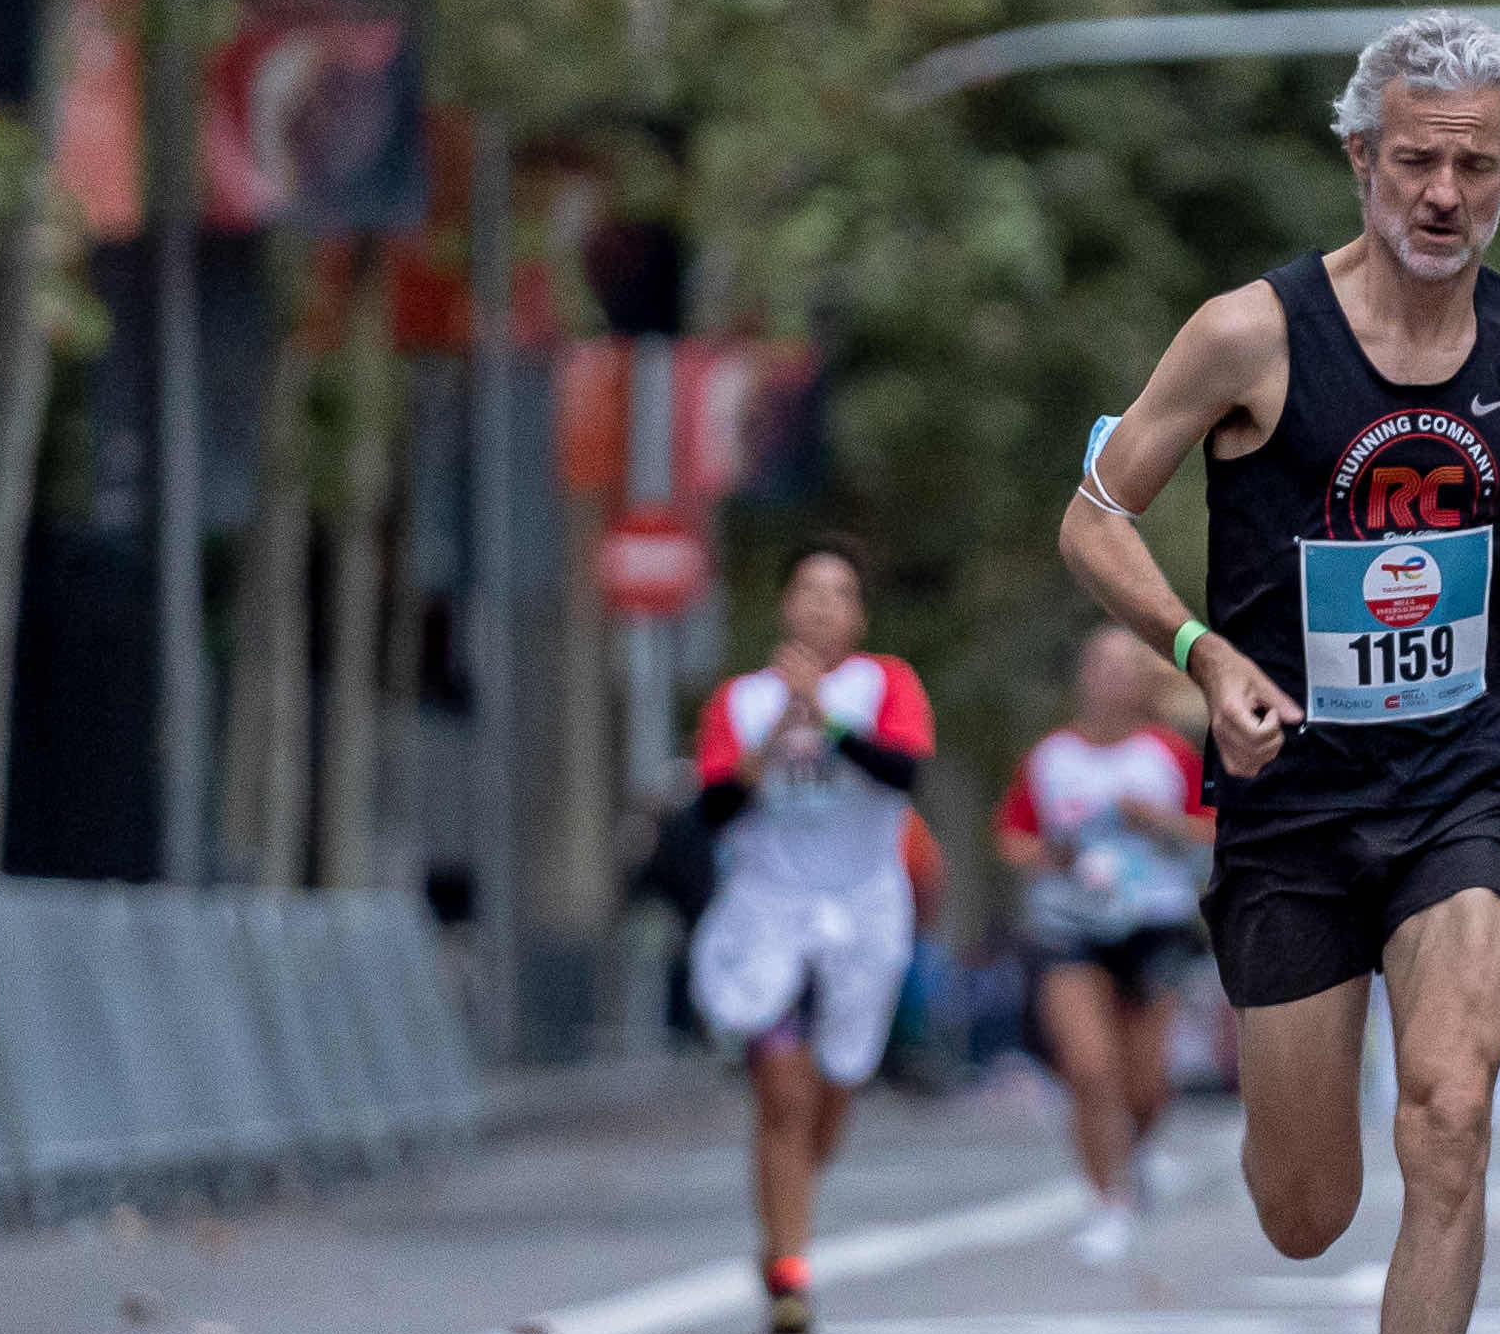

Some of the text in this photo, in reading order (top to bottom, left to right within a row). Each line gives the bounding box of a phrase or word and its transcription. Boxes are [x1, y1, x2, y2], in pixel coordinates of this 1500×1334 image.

[1335, 414, 1495, 488] RUNNING COMPANY
[1366, 467, 1466, 529] RC
[1349, 625, 1454, 685] 1159
